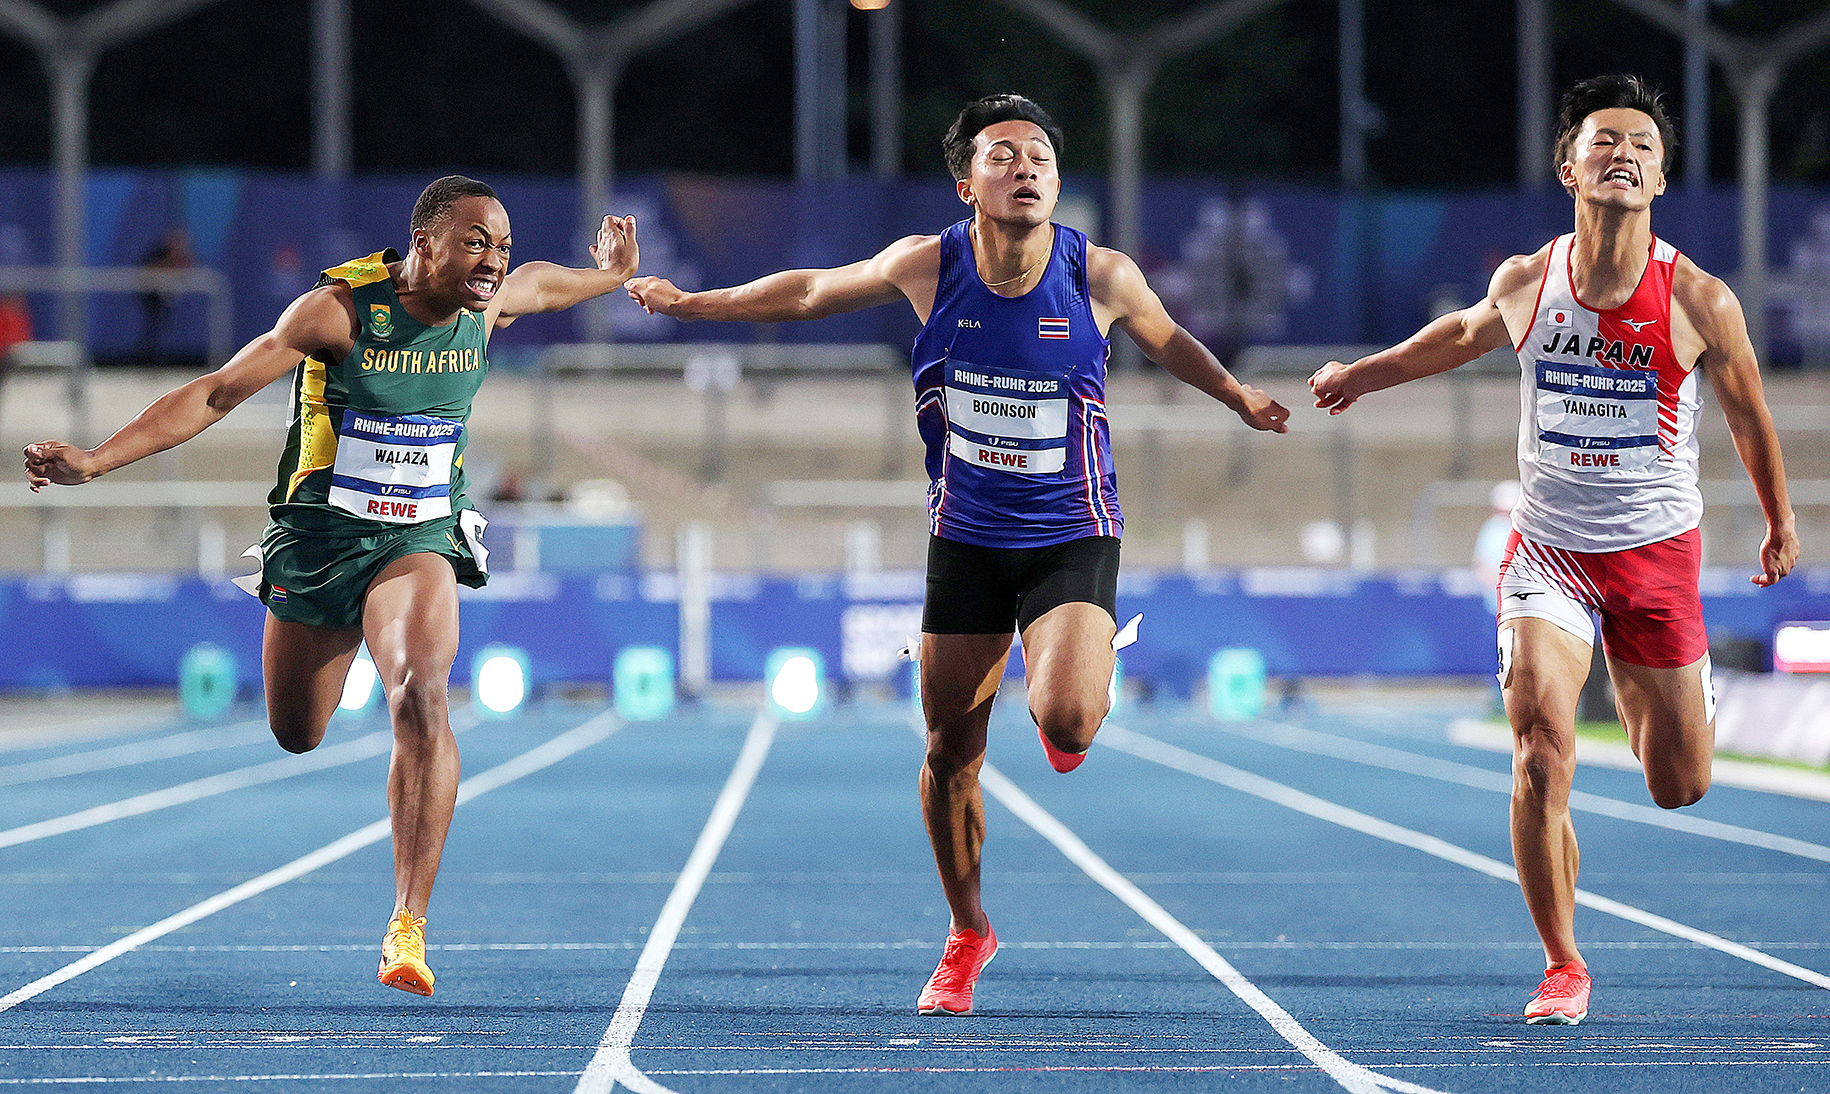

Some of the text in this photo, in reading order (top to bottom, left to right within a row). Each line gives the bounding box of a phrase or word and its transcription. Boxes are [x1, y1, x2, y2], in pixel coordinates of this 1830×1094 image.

[1542, 332, 1655, 368] JAPAN
[361, 347, 480, 375] SOUTH AFRICA
[954, 369, 1059, 393] RHINE-RUHR 2025
[1545, 370, 1647, 393] RHINE-RUHR 2025
[973, 399, 1037, 419] BOONSON
[1562, 399, 1628, 419] YANAGITA
[353, 417, 456, 438] RHINE-RUHR 2025
[375, 448, 429, 466] WALAZA
[978, 449, 1028, 469] REWE
[1570, 451, 1621, 467] REWE
[367, 499, 418, 519] REWE
